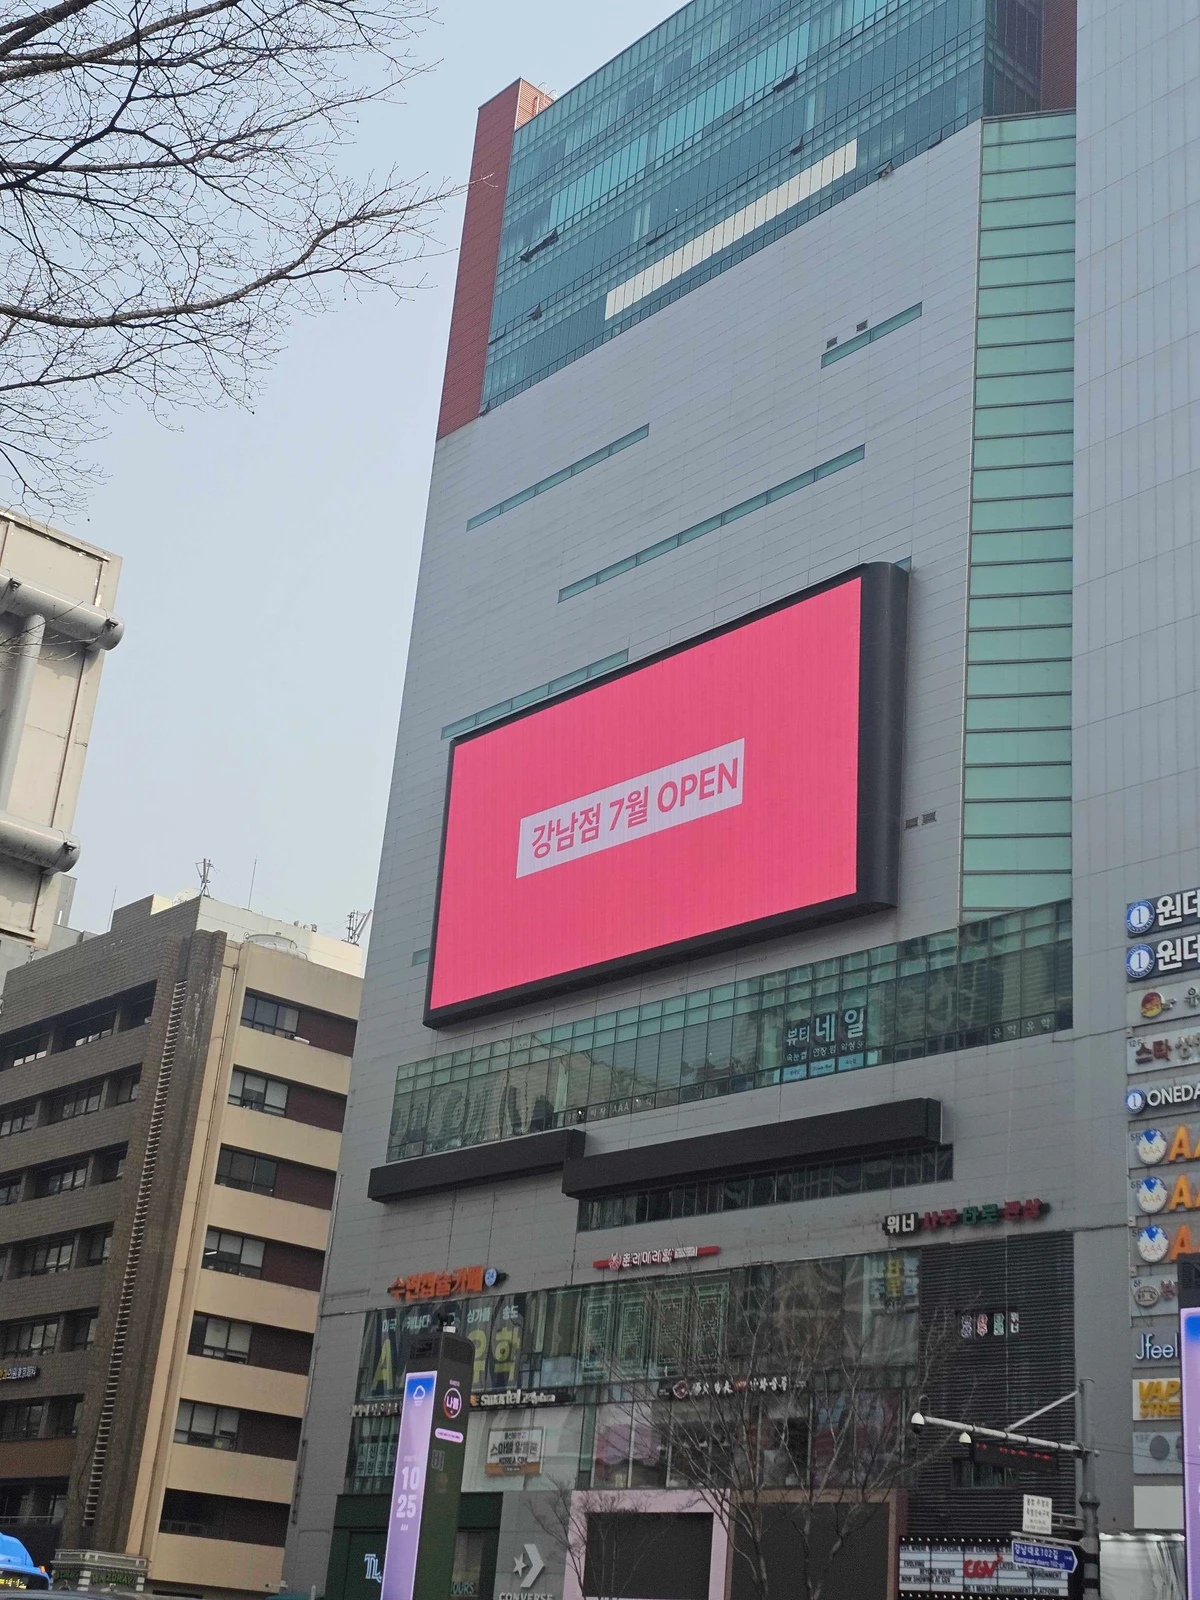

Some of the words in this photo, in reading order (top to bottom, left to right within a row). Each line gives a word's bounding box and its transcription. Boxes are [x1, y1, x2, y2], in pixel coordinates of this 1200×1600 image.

[531, 802, 601, 859] 강남점
[608, 785, 649, 831] 7월
[657, 757, 739, 813] OPEN
[786, 1025, 810, 1046] 뷰티
[815, 1008, 864, 1042] 네일
[887, 1213, 915, 1234] 위너
[922, 1208, 958, 1231] 사주
[961, 1203, 999, 1226] 타로
[1003, 1198, 1044, 1222] 관상
[502, 1305, 519, 1320] 송도
[382, 1318, 398, 1332] 미국
[1135, 1331, 1178, 1360] Jfeel
[480, 1388, 522, 1406] smartel
[402, 1466, 420, 1490] 10
[396, 1494, 417, 1518] 25
[1014, 1543, 1059, 1560] 강남대로102길
[963, 1559, 999, 1579] CGV
